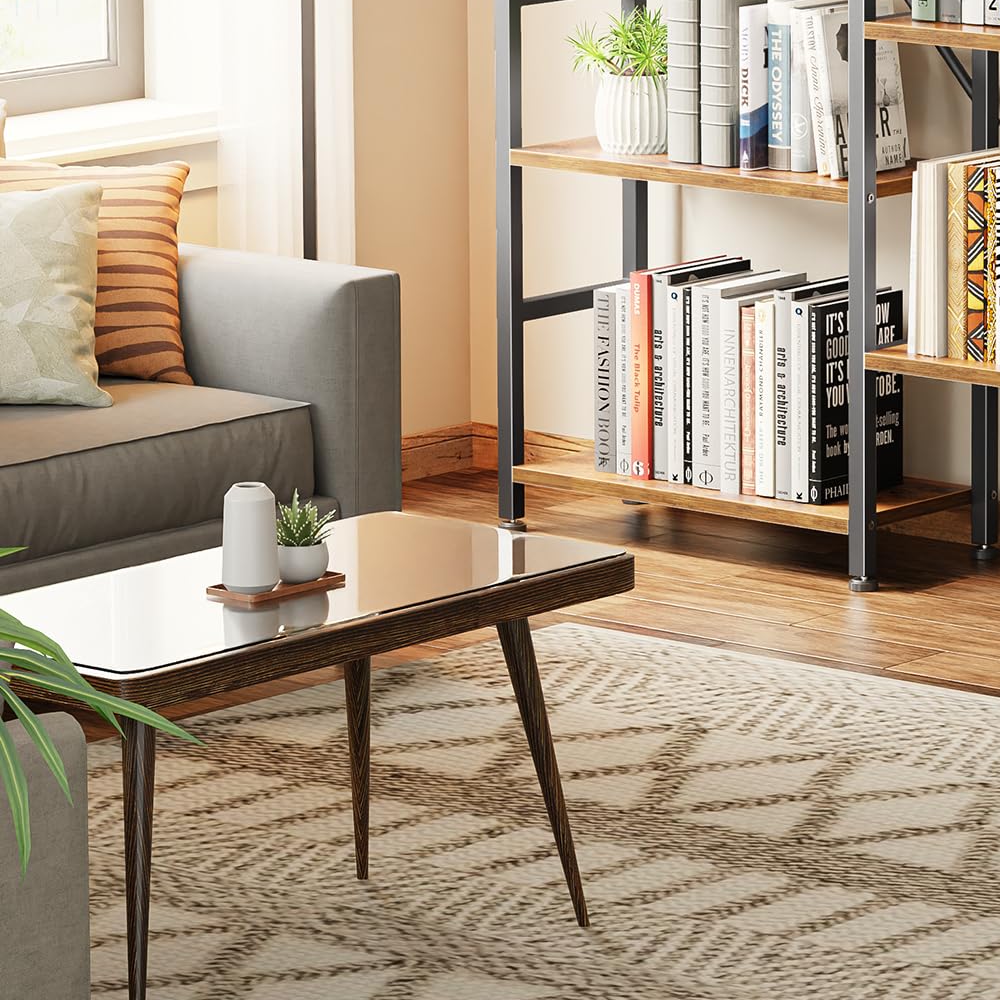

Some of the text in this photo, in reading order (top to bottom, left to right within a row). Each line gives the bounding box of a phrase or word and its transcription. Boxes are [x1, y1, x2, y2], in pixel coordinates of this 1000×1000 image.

[741, 68, 749, 107] DICK
[771, 31, 783, 143] THE ODYSSEY
[654, 329, 665, 349] arts
[825, 311, 844, 336] IT'S
[633, 283, 641, 414] DUMAS The Black Tulip
[777, 346, 788, 367] arts
[597, 294, 610, 468] THE FASHION BOOK
[825, 359, 845, 384] IT'S
[654, 365, 665, 427] architecture
[724, 328, 736, 481] INNENARCHITEKTUR
[777, 384, 788, 446] architecture
[825, 384, 845, 409] YOU
[825, 423, 838, 439] The
